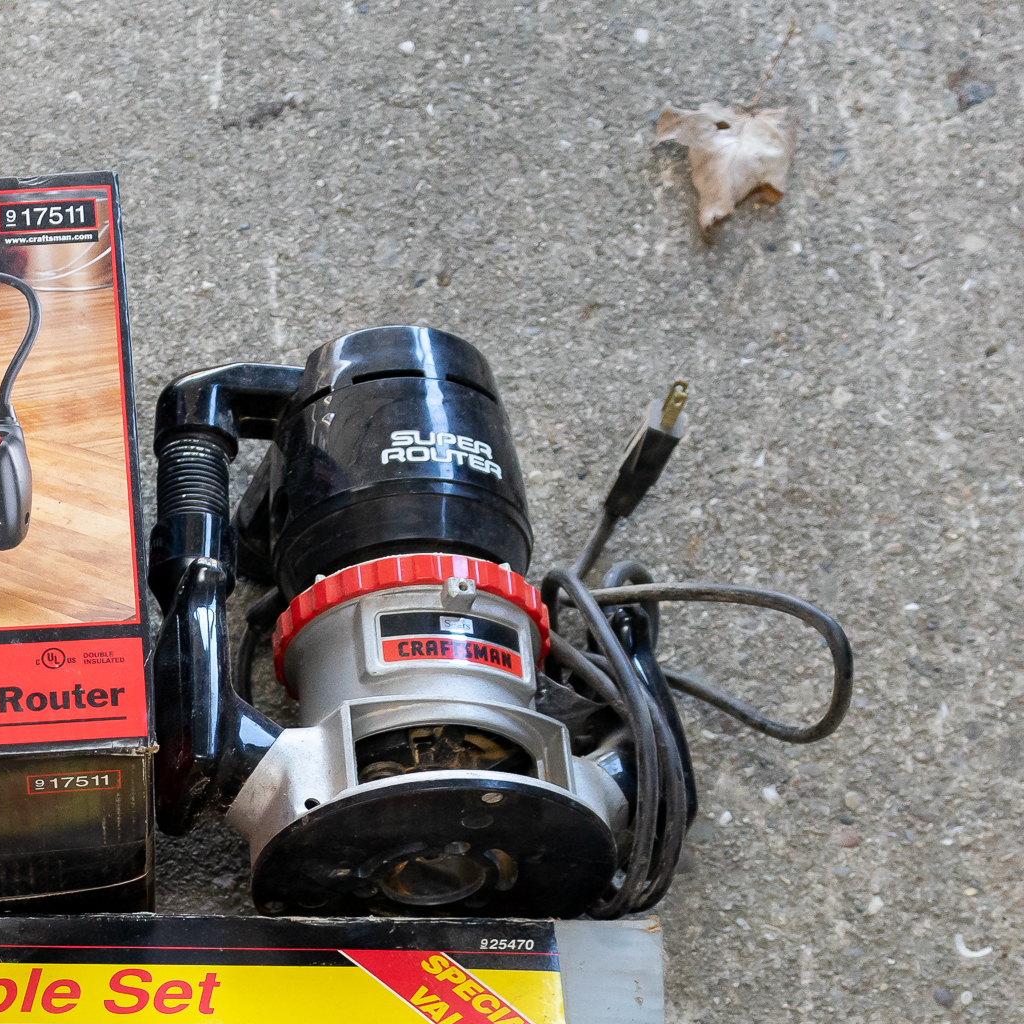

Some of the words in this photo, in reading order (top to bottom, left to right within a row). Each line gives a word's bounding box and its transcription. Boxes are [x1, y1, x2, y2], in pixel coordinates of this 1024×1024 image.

[21, 205, 84, 226] 17511
[5, 234, 92, 244] www.craftsman.com
[390, 429, 493, 460] SUPER
[381, 446, 502, 479] ROUTER
[398, 640, 512, 669] CRAFTSMAN
[49, 774, 110, 789] 17511
[103, 968, 221, 1015] Set
